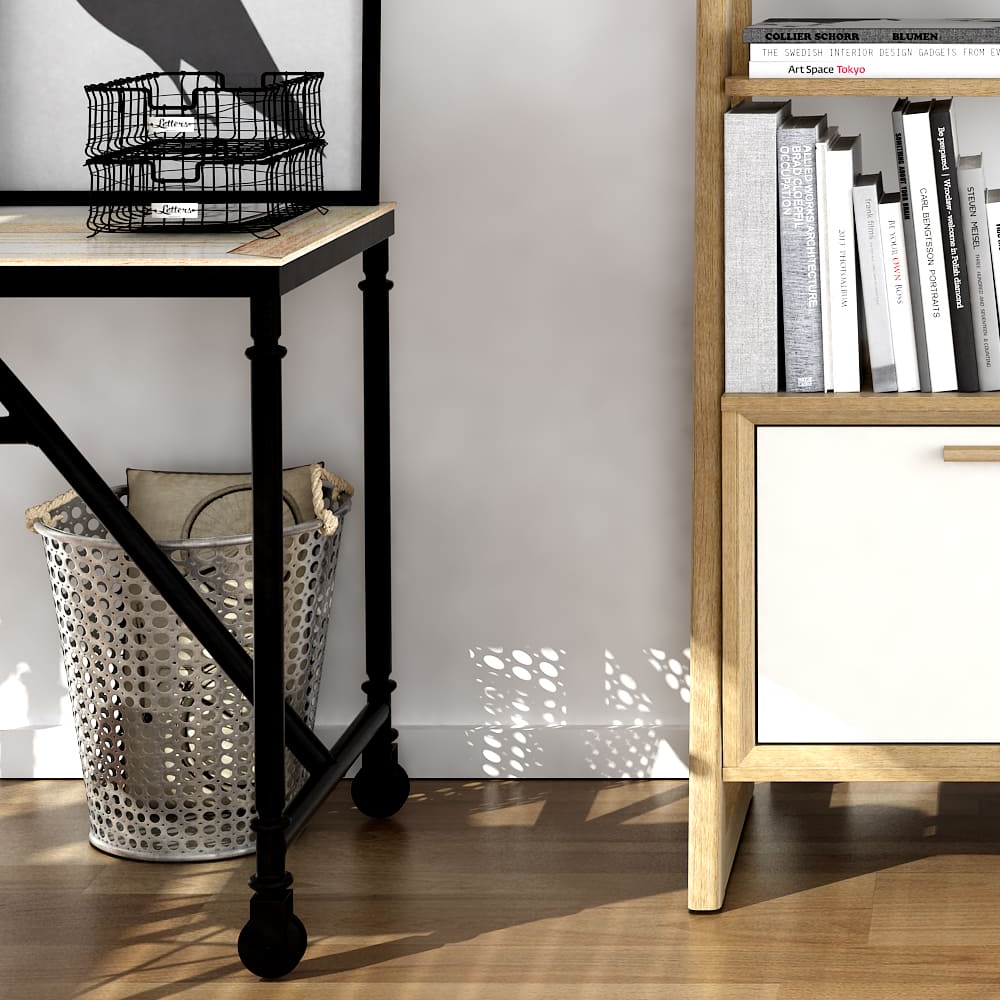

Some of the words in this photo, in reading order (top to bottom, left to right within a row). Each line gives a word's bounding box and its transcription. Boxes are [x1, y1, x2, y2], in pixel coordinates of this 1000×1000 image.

[765, 32, 812, 41] COLLIER
[814, 32, 860, 41] SCHORR
[892, 32, 938, 41] BLUMEN
[762, 48, 779, 57] THE
[784, 48, 823, 57] SWEDISH
[830, 48, 874, 57] INTERIOR
[879, 48, 913, 57] DESIGN
[918, 48, 957, 57] GADGETS
[963, 48, 985, 57] FROM
[788, 65, 804, 74] Art
[806, 65, 834, 75] Space
[836, 65, 866, 75] Tokyo
[154, 118, 189, 129] Letters
[937, 127, 945, 137] Be
[791, 146, 801, 177] BRAD
[803, 145, 814, 181] ALLIED
[780, 146, 791, 216] OCCUPATION
[898, 166, 907, 184] ABOUT
[157, 204, 192, 215] Letters
[804, 183, 815, 222] WORKS
[920, 187, 929, 211] CARL
[967, 186, 977, 217] STEVEN
[888, 220, 896, 229] BE
[947, 215, 956, 247] welcome
[970, 221, 980, 250] MEISEL
[889, 231, 898, 255] YOUR
[922, 212, 935, 266] BENGTSSON
[806, 224, 818, 308] ARCHITECTURE
[892, 257, 901, 280] OWN
[951, 255, 961, 276] Polish
[839, 250, 848, 308] PHOTOALBUM
[895, 284, 904, 304] BOSS
[929, 269, 941, 318] PORTRAITS
[953, 277, 964, 309] diamond
